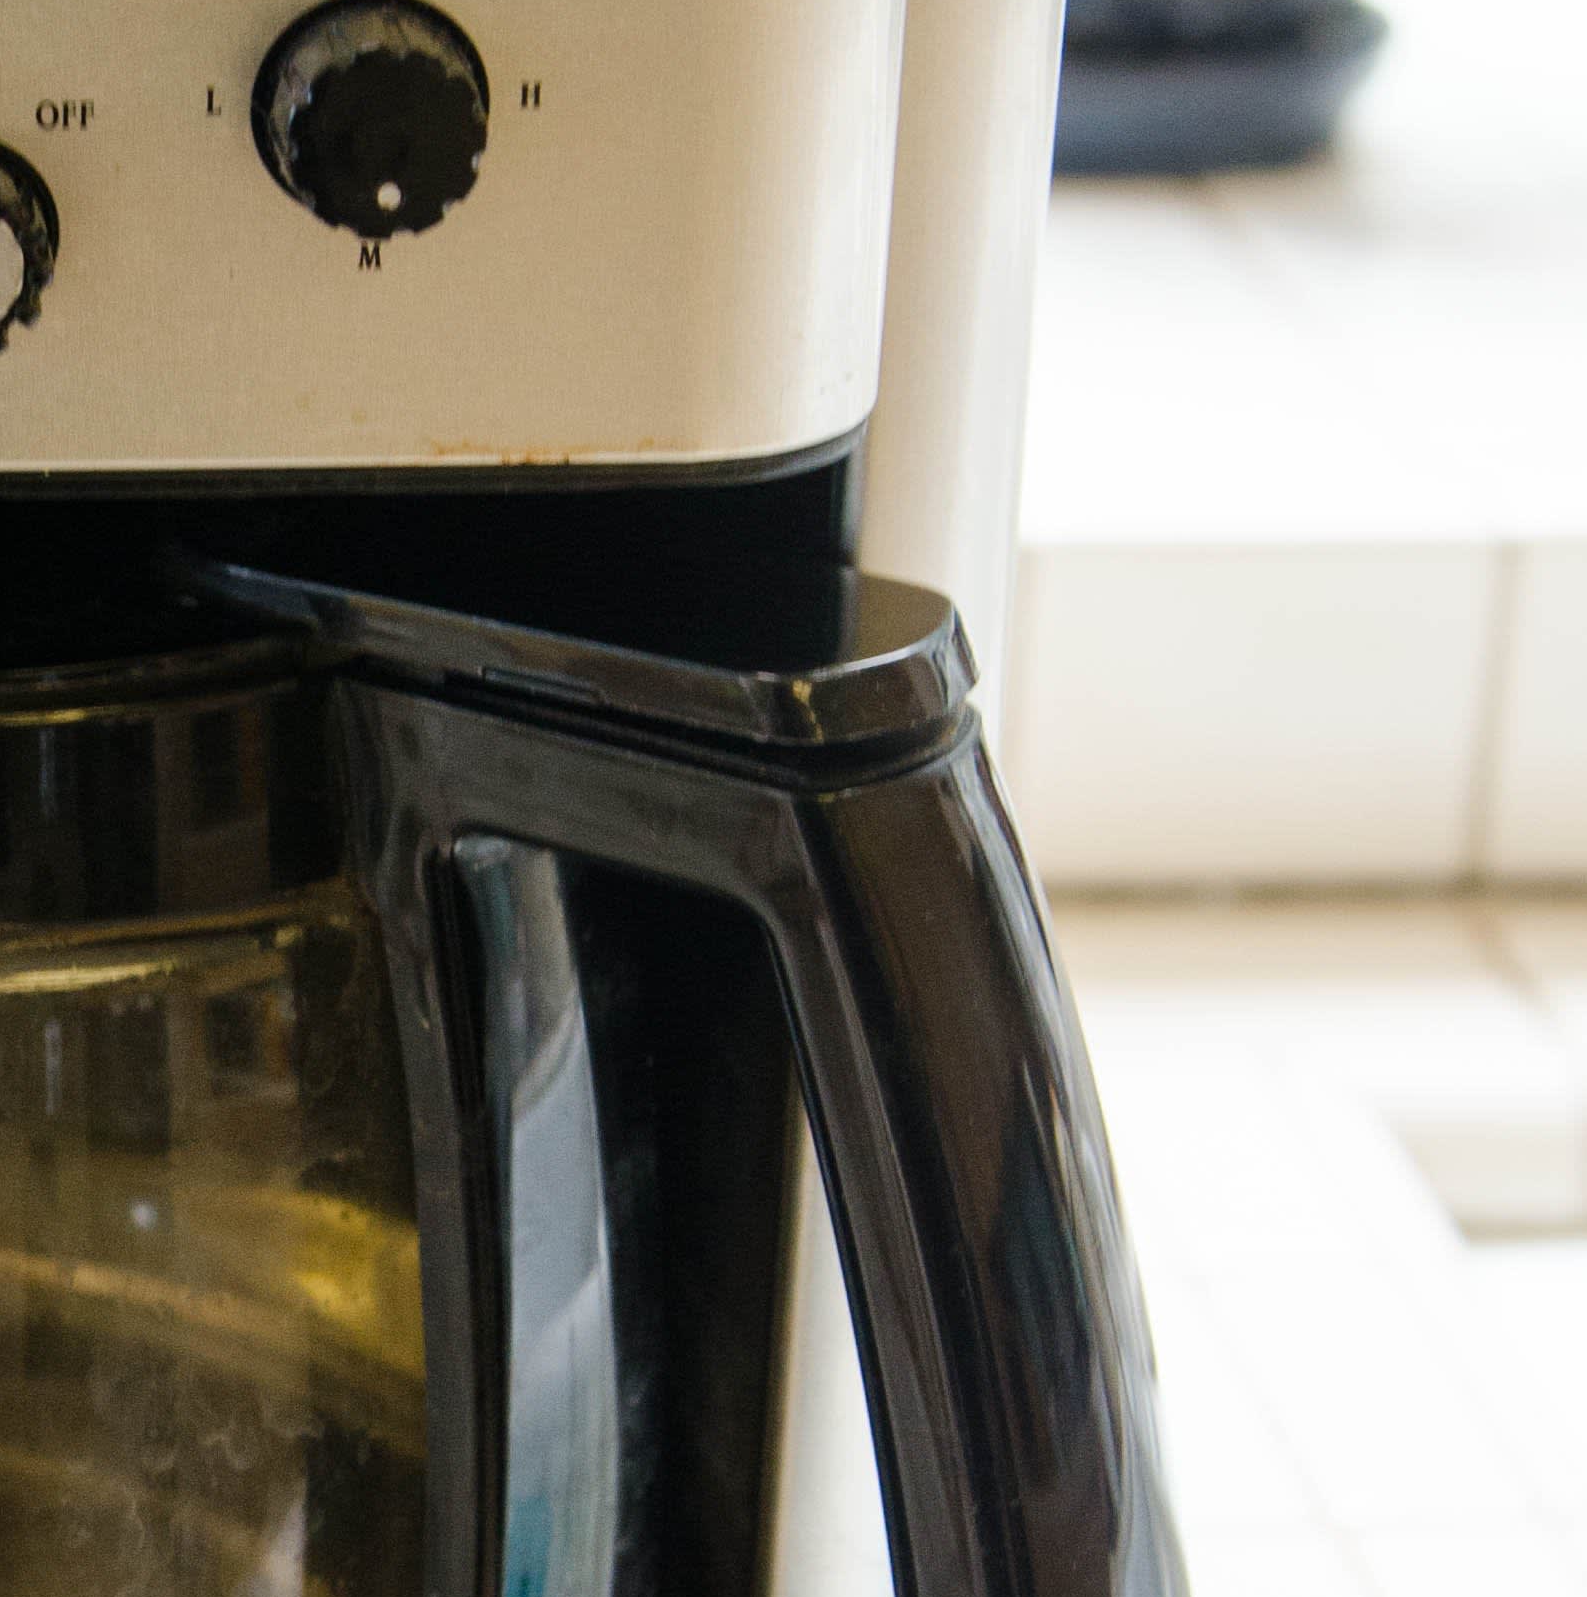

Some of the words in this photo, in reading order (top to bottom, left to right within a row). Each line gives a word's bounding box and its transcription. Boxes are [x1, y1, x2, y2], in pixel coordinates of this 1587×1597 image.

[205, 85, 223, 116] L
[520, 81, 541, 109] H
[35, 99, 95, 131] OFF
[359, 244, 382, 270] M
